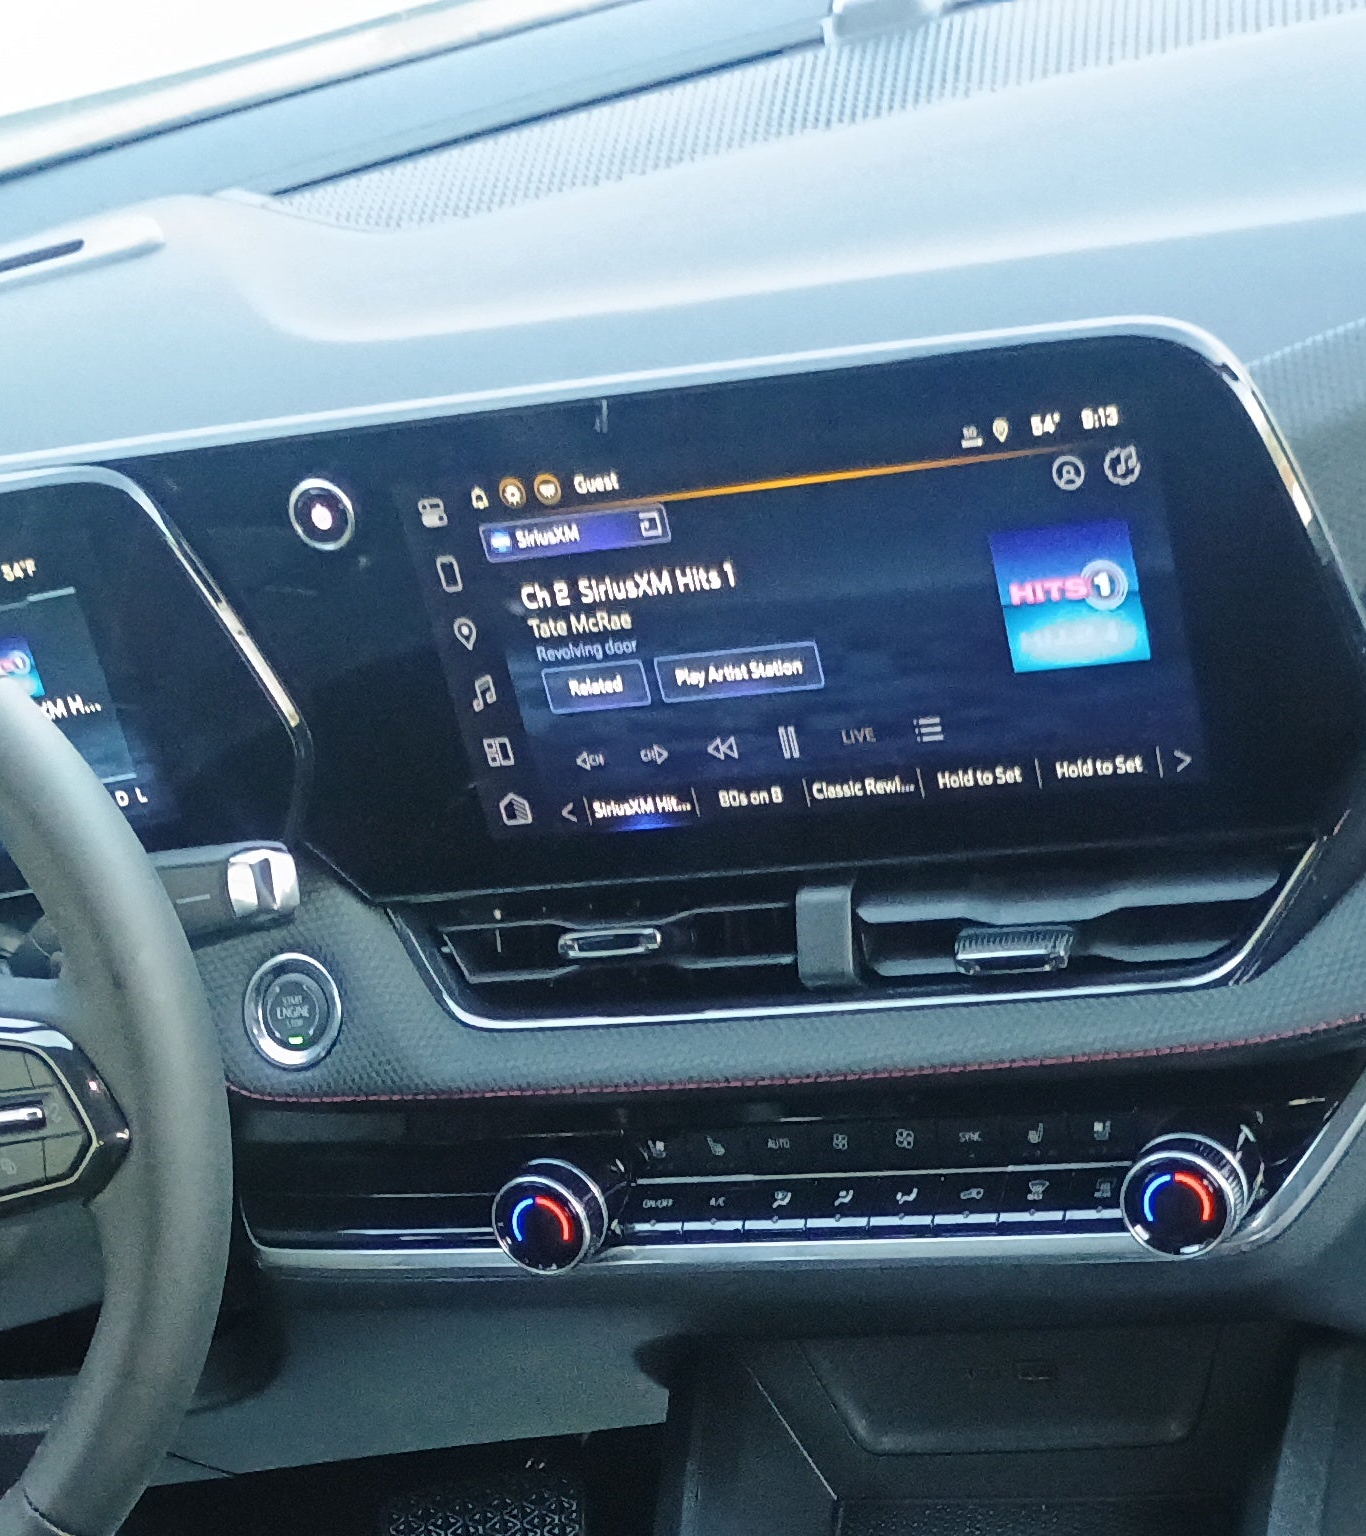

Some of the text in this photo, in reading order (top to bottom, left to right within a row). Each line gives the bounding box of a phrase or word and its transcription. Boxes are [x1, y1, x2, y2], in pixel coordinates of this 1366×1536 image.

[573, 469, 619, 495] Guest
[515, 523, 580, 549] SiriusXM
[521, 583, 551, 610] Ch
[578, 569, 673, 604] SiriusXM
[676, 565, 721, 593] Hits
[723, 561, 735, 588] 1
[1009, 576, 1090, 605] HITS
[527, 609, 632, 639] Tate McRae
[536, 637, 637, 663] Revolving door
[568, 673, 623, 697] Related
[675, 659, 803, 688] Play Artist Station
[841, 728, 877, 745] LIVE
[937, 765, 1022, 790] Hold to Set
[1056, 755, 1143, 779] Hold to Set
[115, 790, 129, 807] D
[751, 790, 769, 805] on
[812, 778, 863, 800] Classic
[592, 797, 654, 818] SiriusXM
